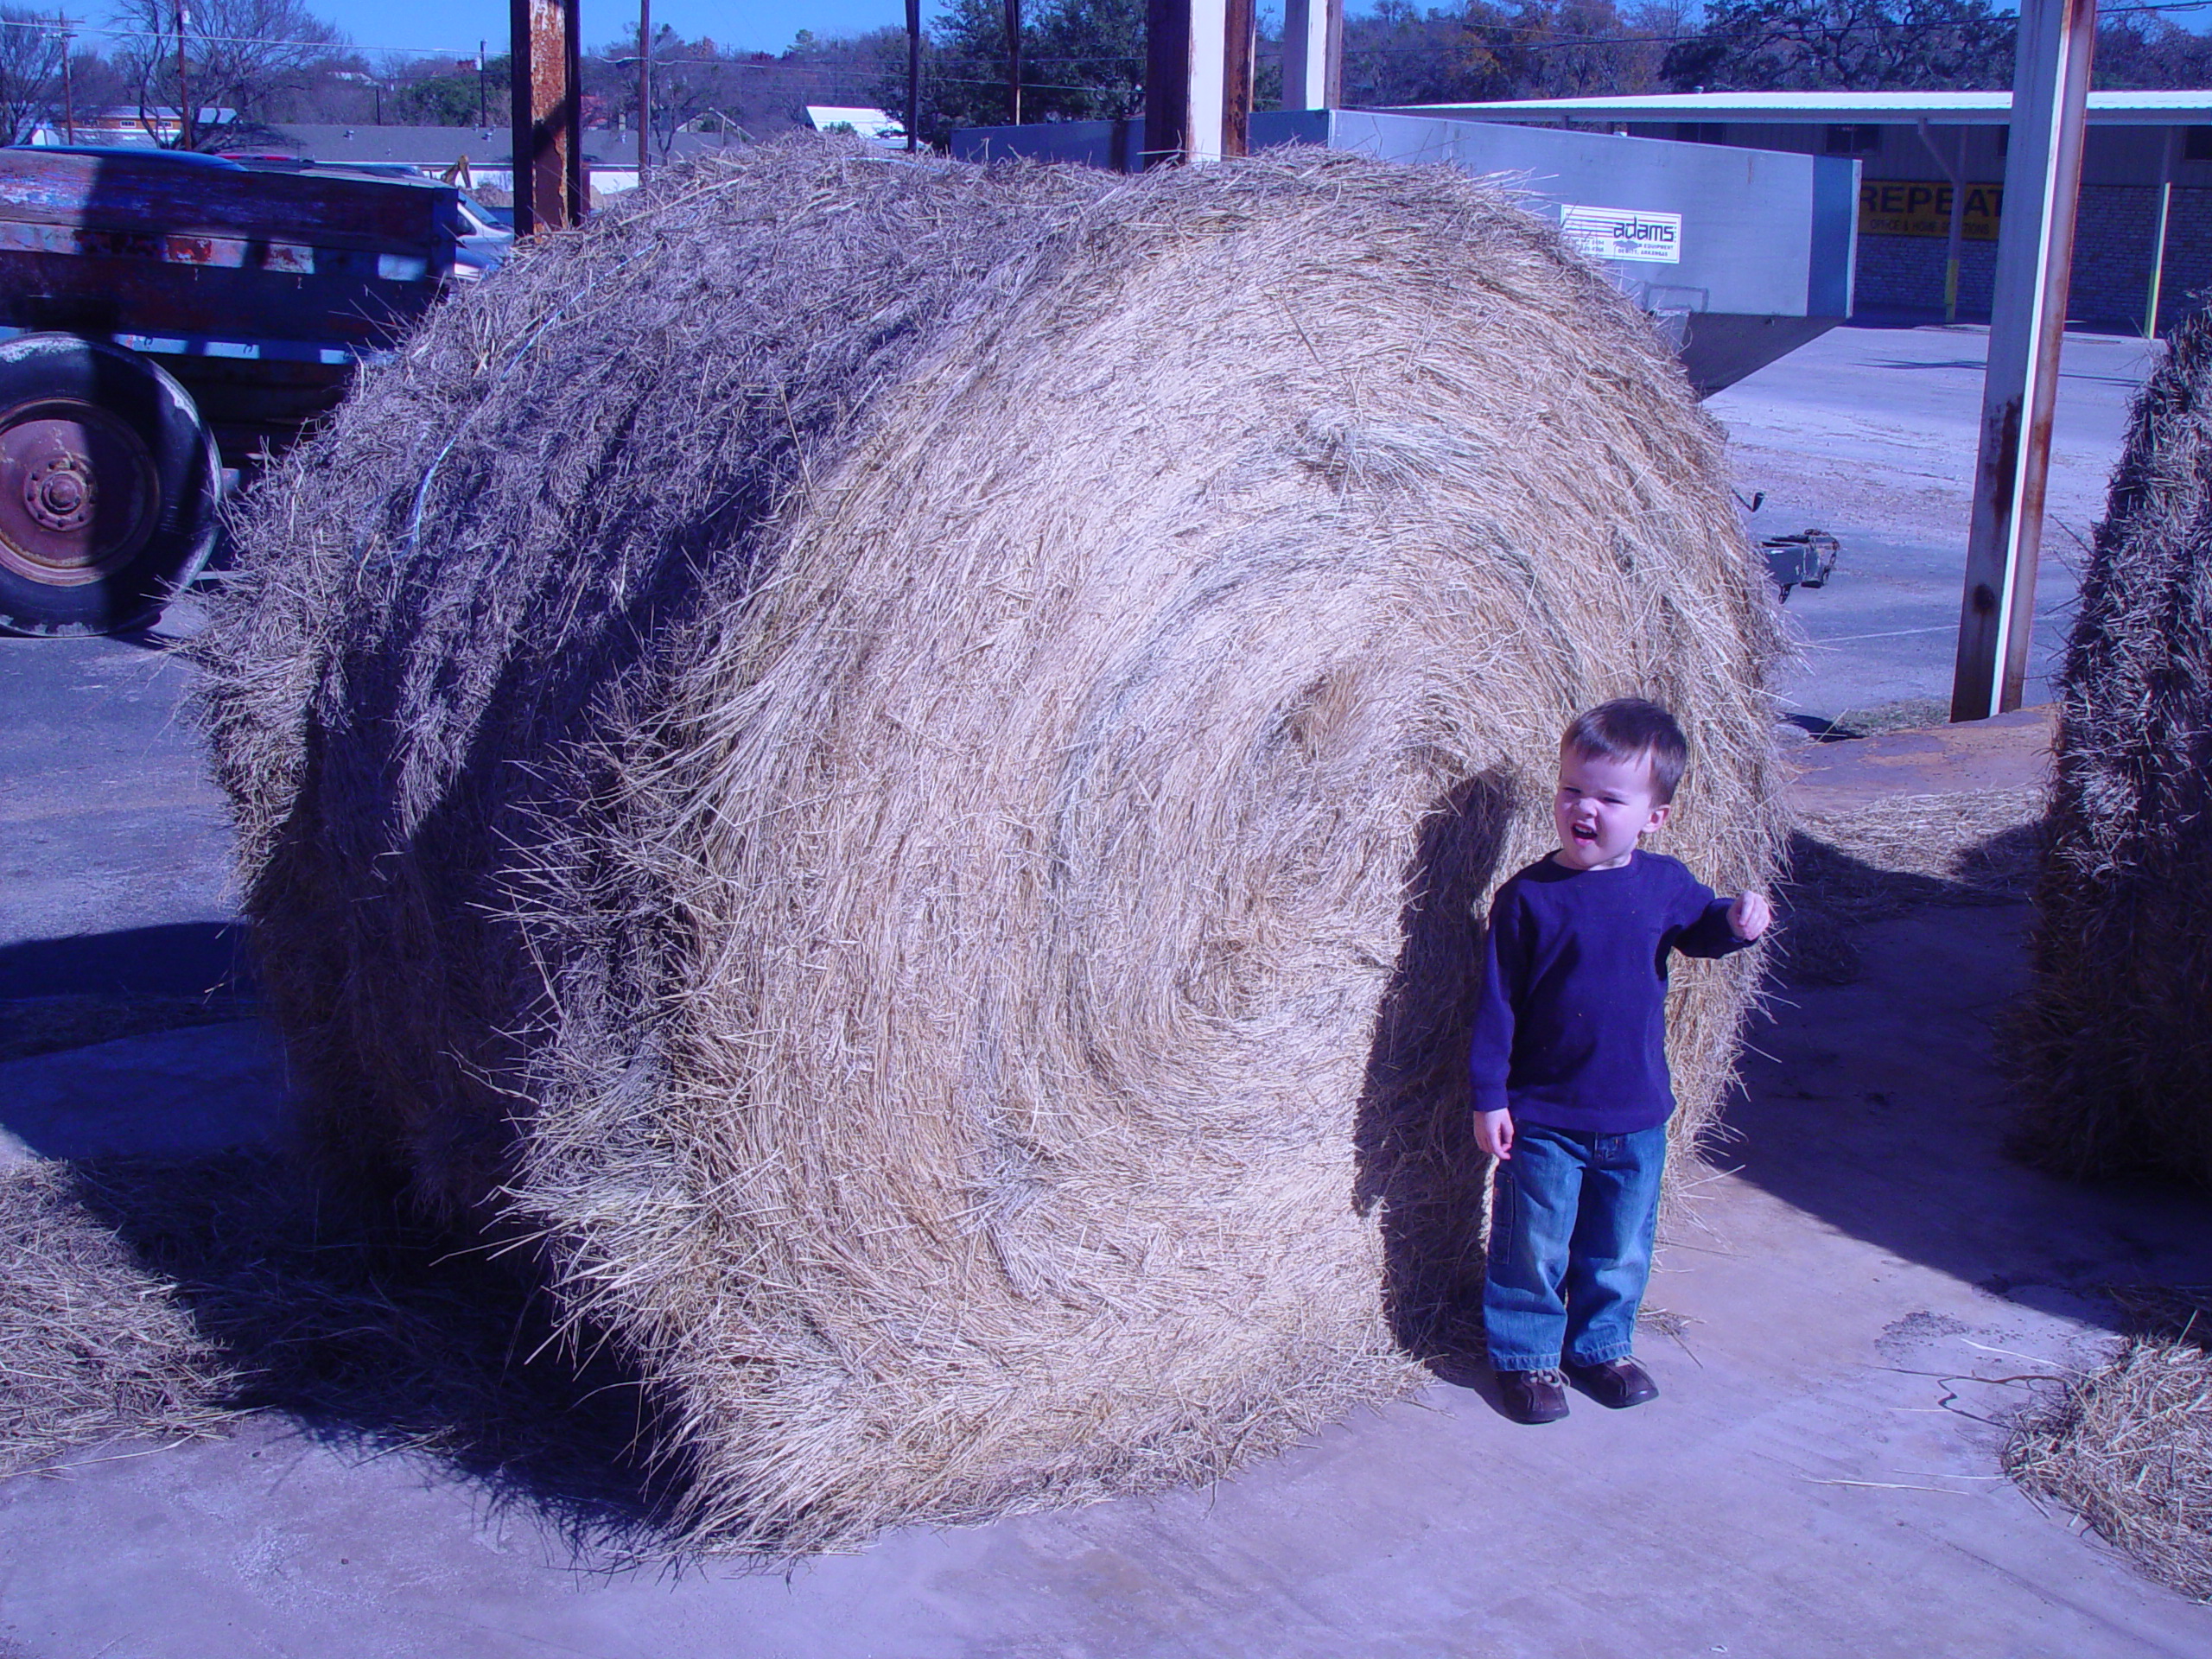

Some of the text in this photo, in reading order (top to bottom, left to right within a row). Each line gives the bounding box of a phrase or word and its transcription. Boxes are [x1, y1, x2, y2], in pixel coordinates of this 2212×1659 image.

[1859, 186, 2004, 217] REPEAT
[1613, 216, 1675, 242] adams
[1870, 219, 1902, 231] OFFICE
[1912, 221, 1937, 232] HOME
